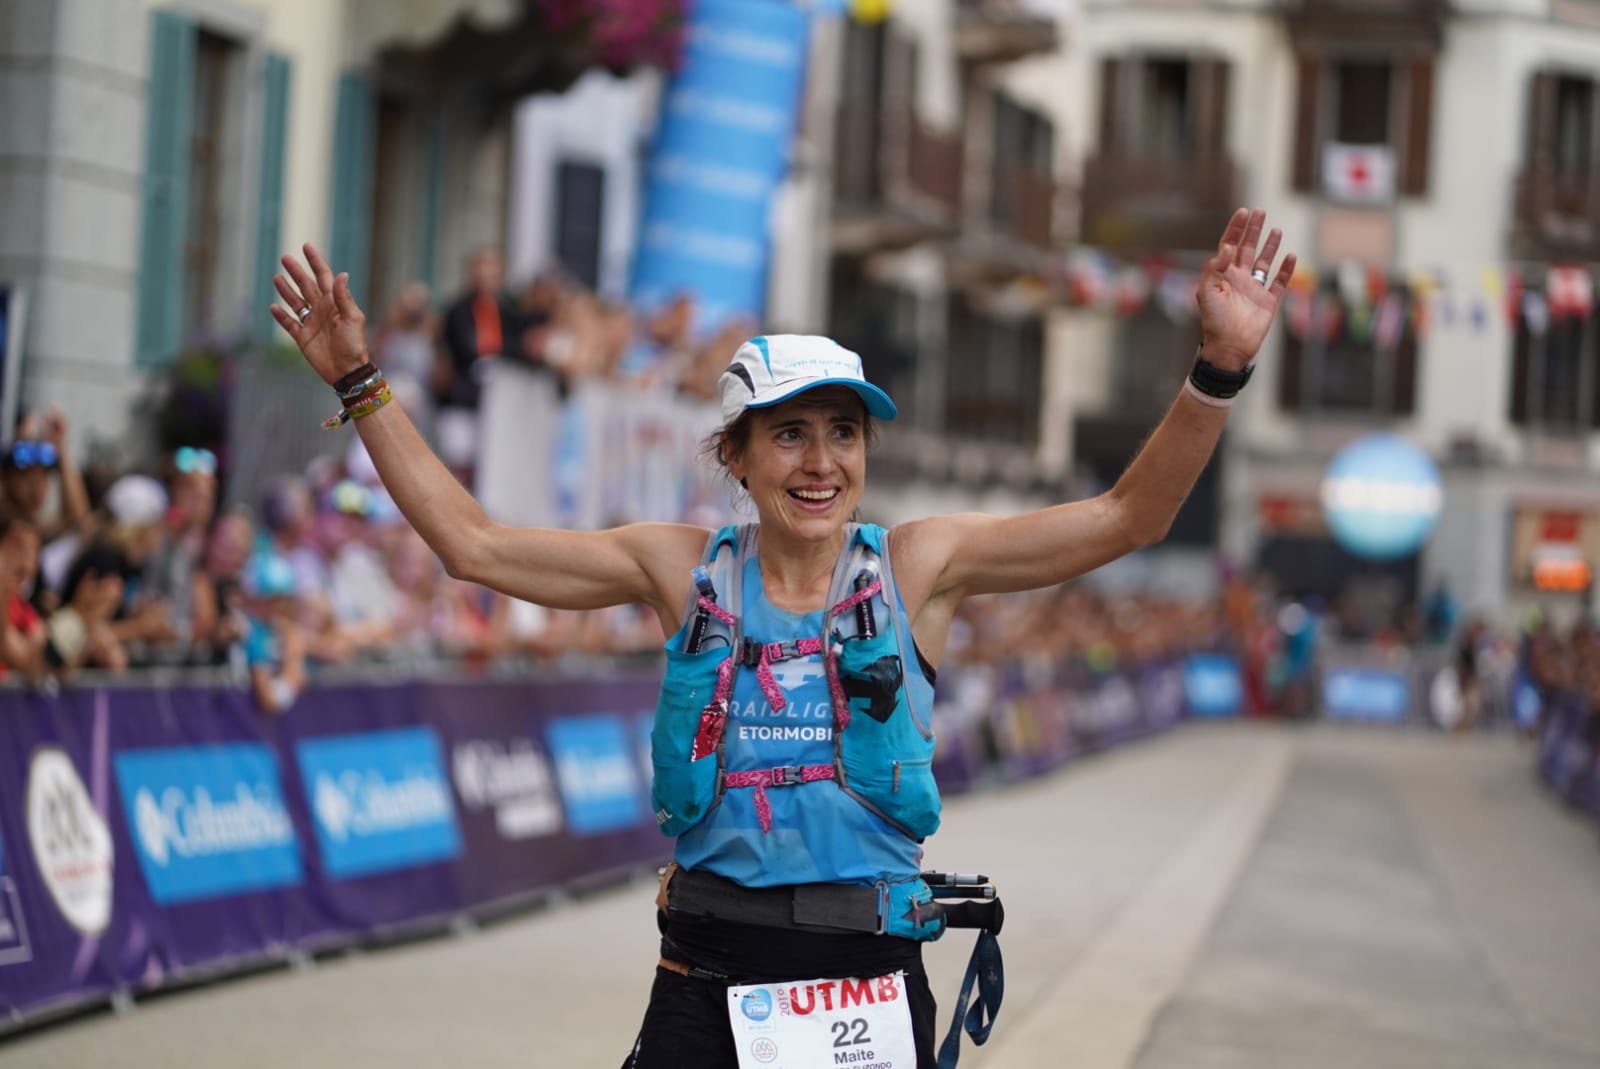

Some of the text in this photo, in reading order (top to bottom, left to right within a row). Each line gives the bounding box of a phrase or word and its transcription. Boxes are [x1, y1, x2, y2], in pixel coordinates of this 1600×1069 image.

[729, 701, 833, 719] RAILIG
[789, 975, 899, 1016] UTMB
[831, 1017, 872, 1049] 22
[834, 1050, 875, 1065] Maite
